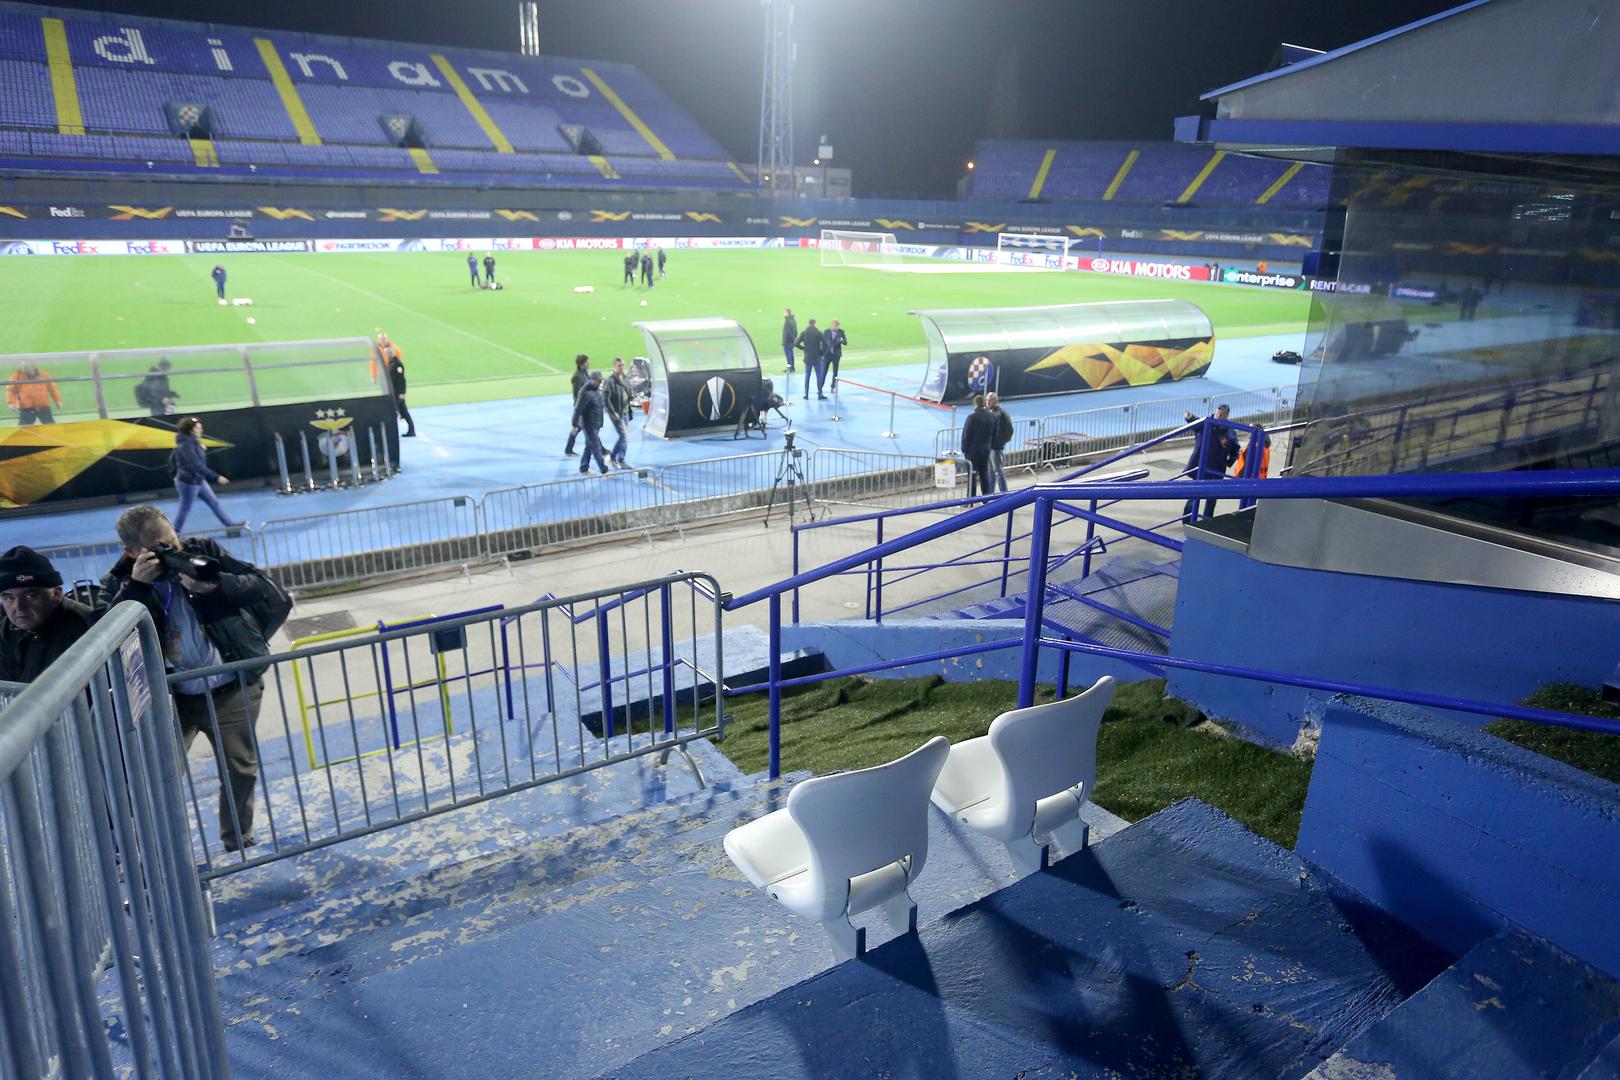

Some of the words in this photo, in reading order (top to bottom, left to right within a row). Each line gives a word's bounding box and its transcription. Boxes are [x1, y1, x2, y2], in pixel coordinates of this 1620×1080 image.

[94, 27, 591, 98] dinamo
[50, 207, 86, 217] FedEx
[53, 241, 99, 255] FedEx
[126, 241, 170, 254] FedEx
[197, 241, 226, 252] UEFA
[229, 241, 267, 252] EUROPA
[270, 241, 305, 252] LEAGUE
[556, 239, 574, 249] KIA
[576, 239, 618, 249] MOTORS
[1010, 253, 1033, 265] FedEx
[1111, 260, 1131, 275] KIA
[1135, 263, 1191, 280] MOTORS
[1227, 269, 1295, 287] enterprise
